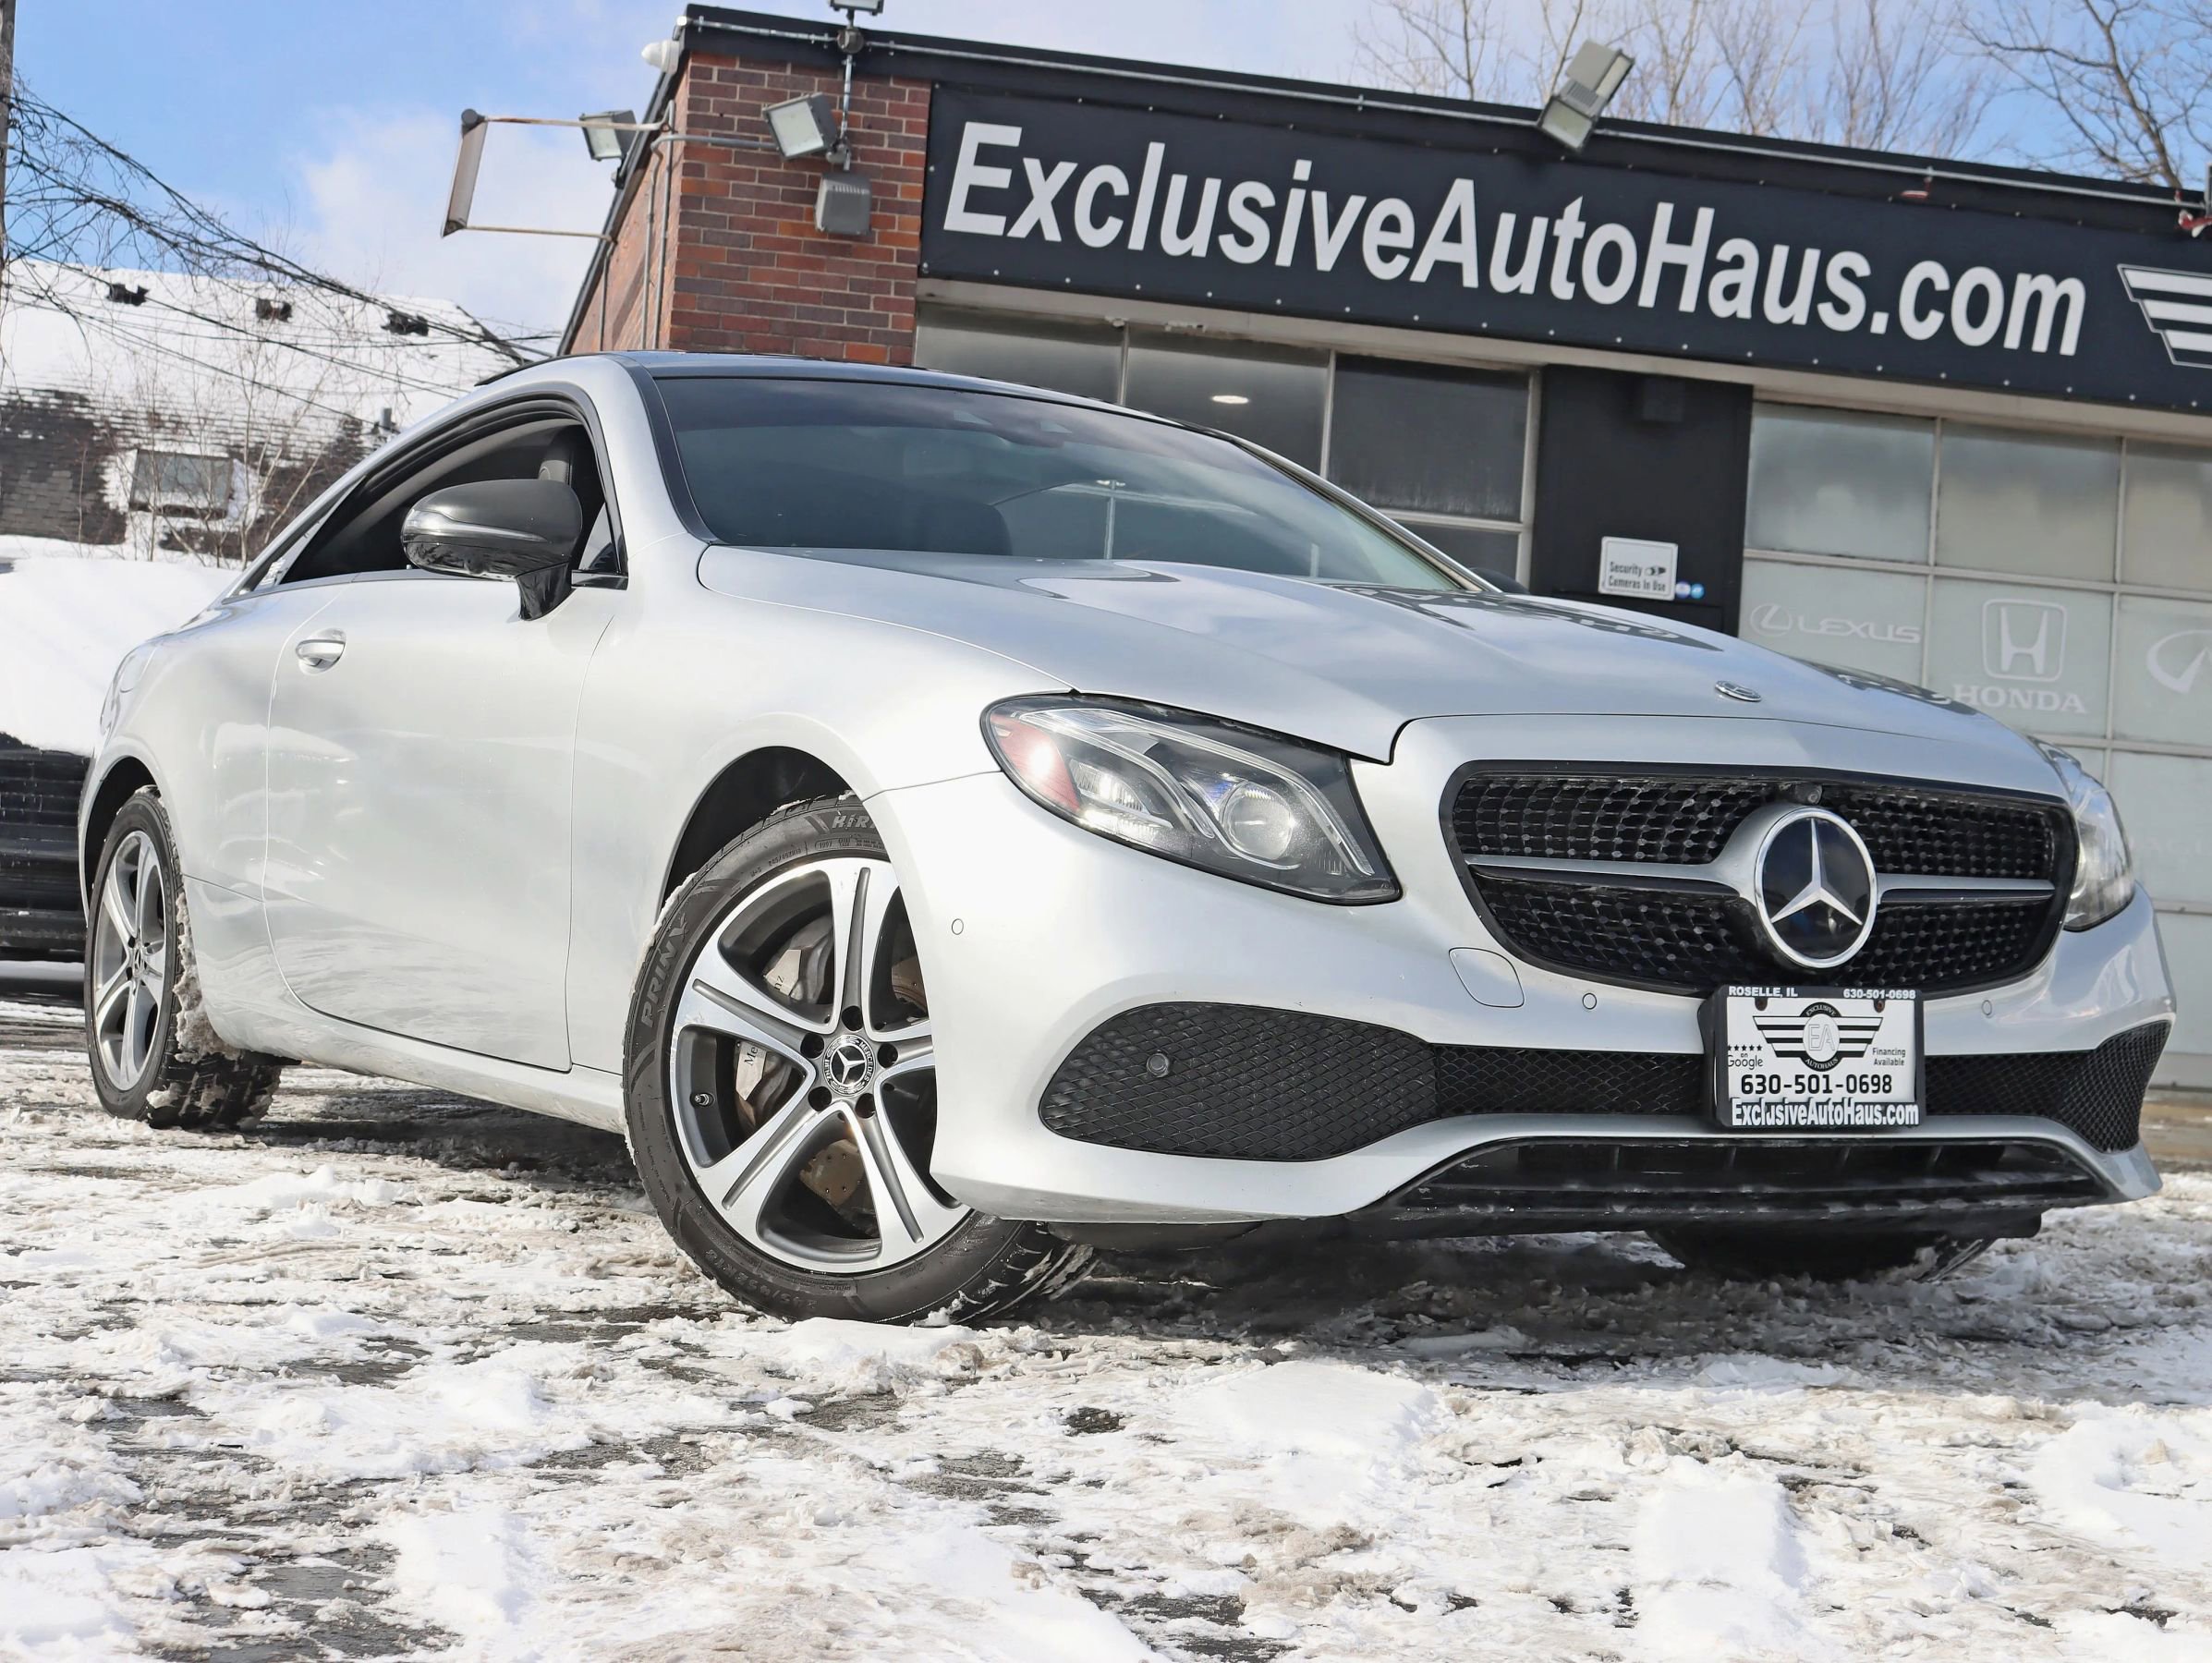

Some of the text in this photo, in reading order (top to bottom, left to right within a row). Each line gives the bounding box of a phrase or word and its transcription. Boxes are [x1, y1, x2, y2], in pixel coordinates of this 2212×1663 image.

[943, 121, 2086, 357] ExclusiveAutoHaus.com
[1610, 561, 1642, 577] Security
[1609, 575, 1641, 589] Cameras
[1653, 580, 1666, 592] Use
[1798, 614, 1921, 644] LEXUS
[1951, 684, 2088, 715] HONDA
[1729, 987, 1916, 1000] ROSELLE, IL 630-501-0698
[1805, 1004, 1837, 1016] EXCLUSIVE
[1872, 1048, 1906, 1058] Financing
[1728, 1054, 1764, 1070] Google
[1805, 1056, 1839, 1070] AUTOHAUS
[1874, 1057, 1905, 1066] Available
[1741, 1074, 1892, 1095] 630-501-0698
[1731, 1097, 1919, 1126] ExclusiveAutoHaus.com
